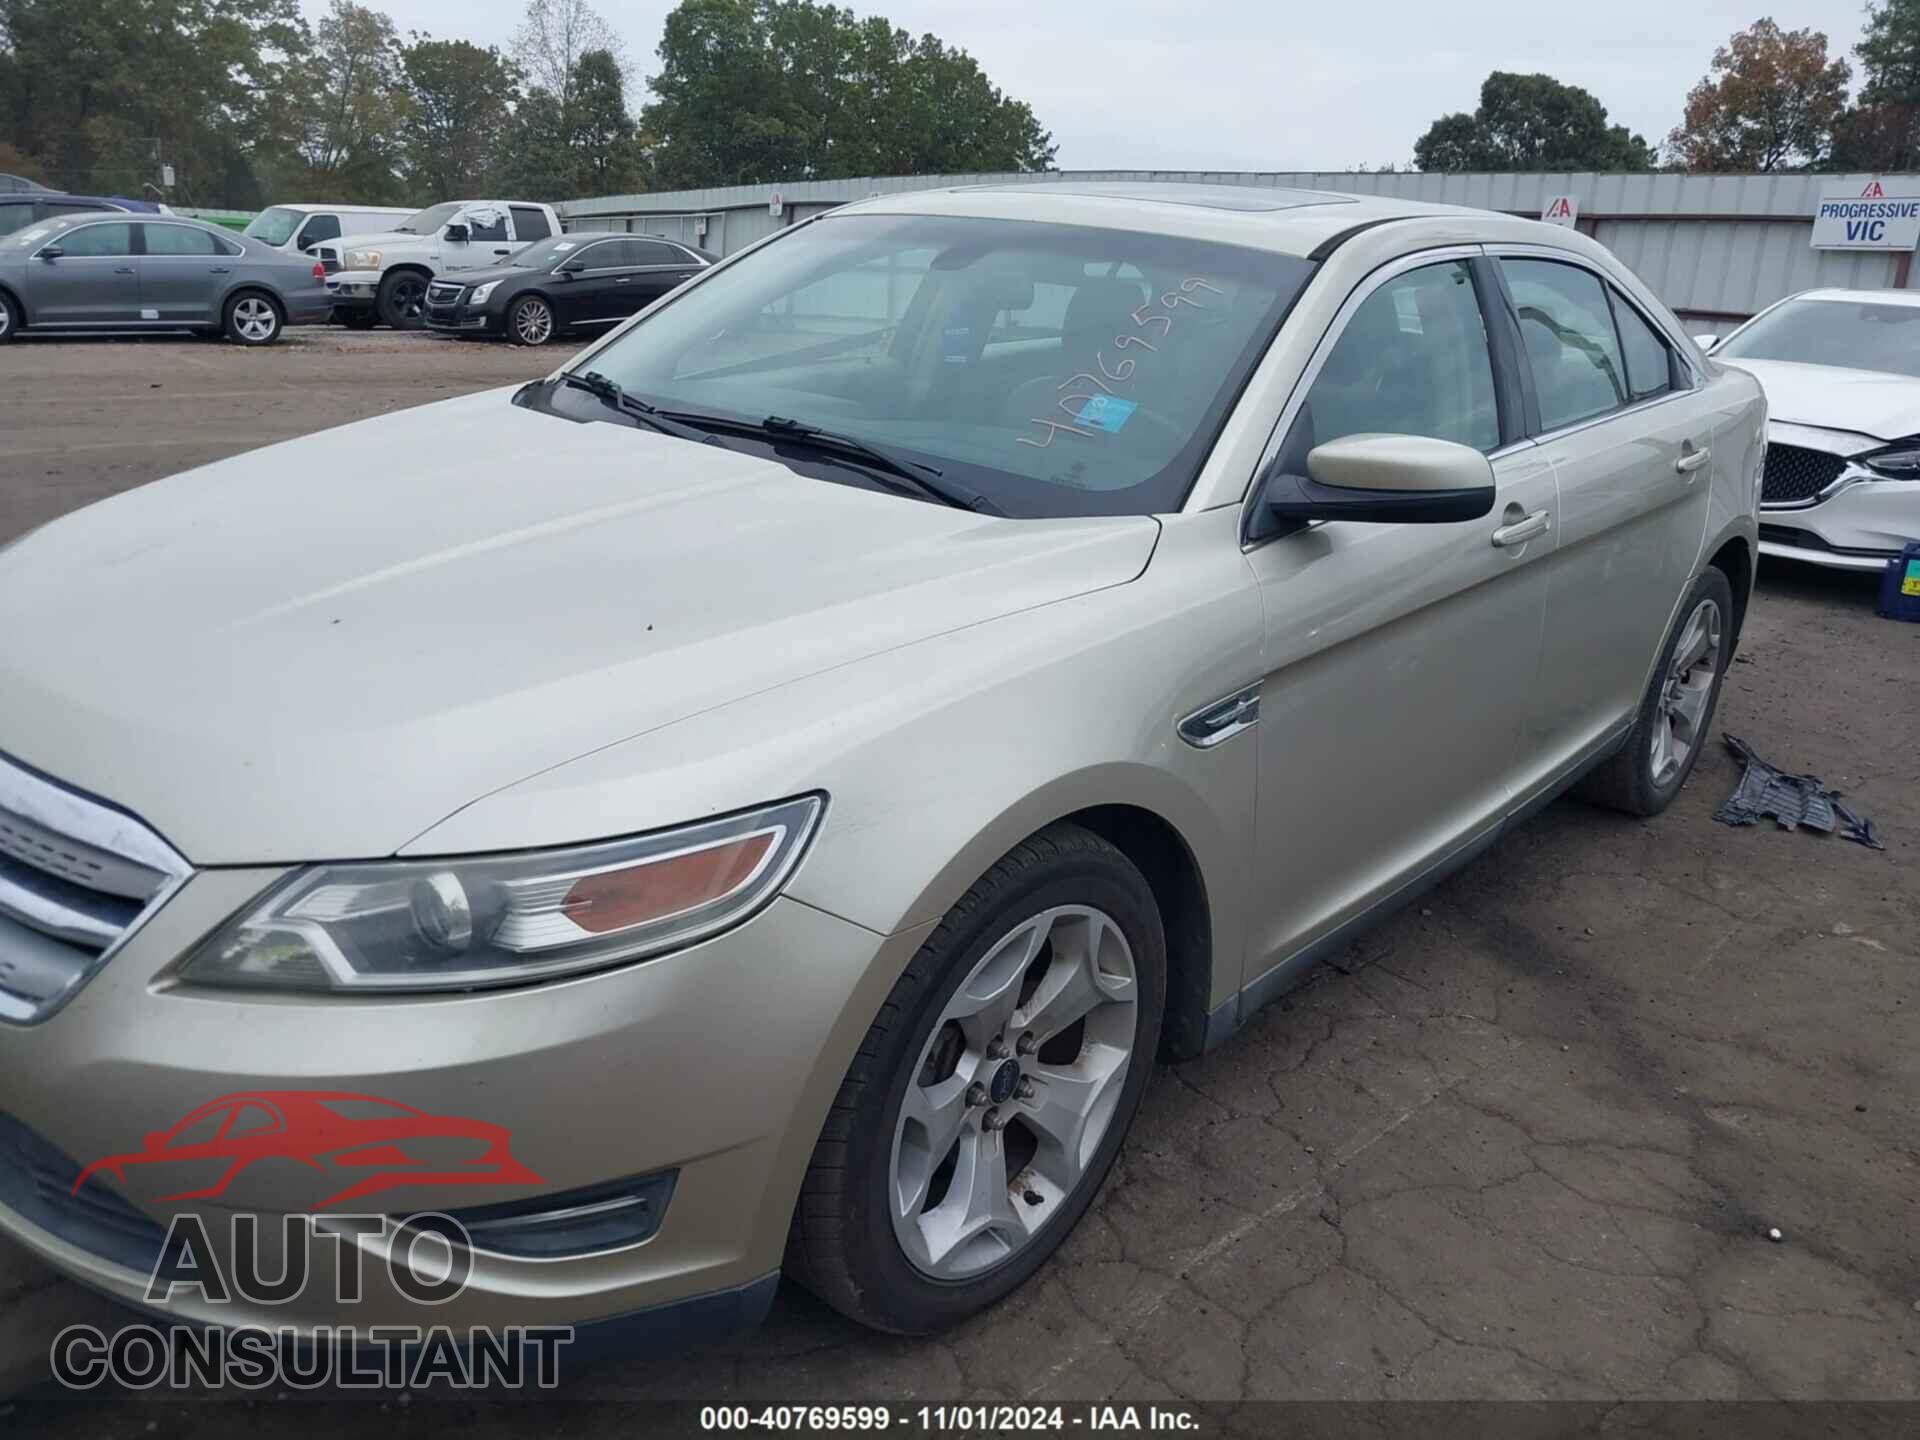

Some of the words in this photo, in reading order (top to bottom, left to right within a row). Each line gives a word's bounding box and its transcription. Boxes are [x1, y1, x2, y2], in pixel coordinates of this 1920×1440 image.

[1820, 202, 1920, 218] PROGRESSIVE
[1846, 220, 1885, 241] VIC
[1015, 277, 1224, 448] 40769599
